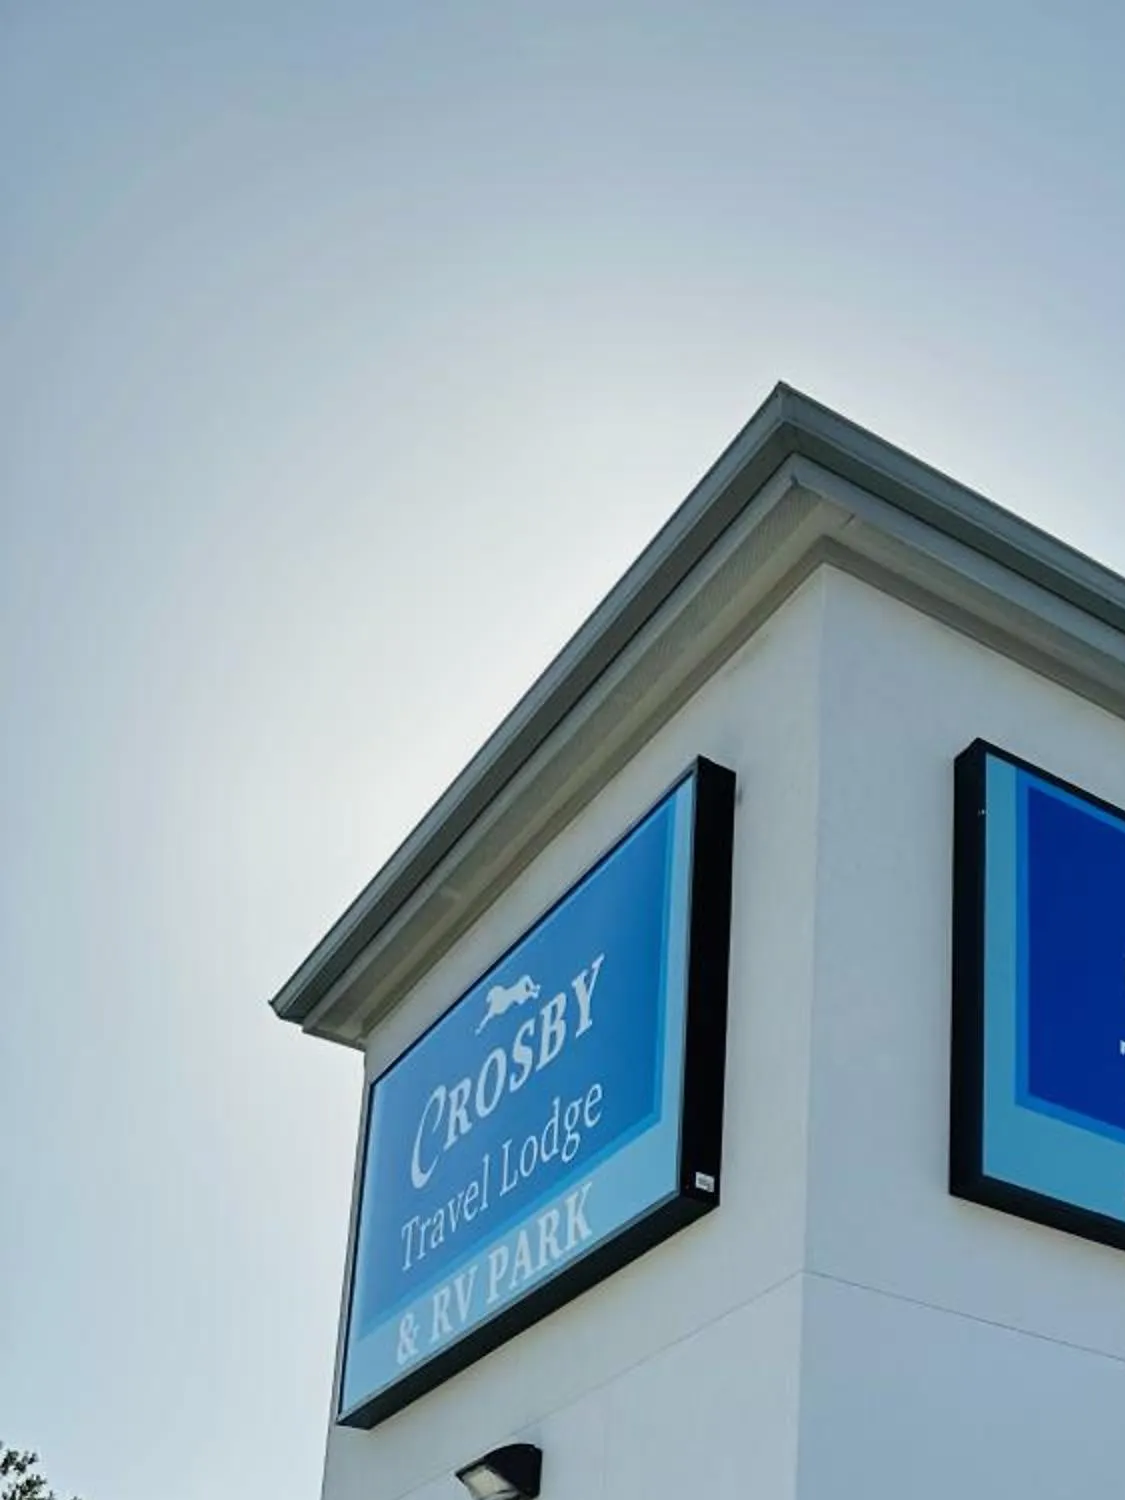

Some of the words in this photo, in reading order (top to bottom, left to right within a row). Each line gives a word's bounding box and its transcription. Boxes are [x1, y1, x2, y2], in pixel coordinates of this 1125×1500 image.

[410, 954, 604, 1188] CROSBY
[401, 1169, 489, 1272] Travel
[500, 1082, 603, 1197] Lodge
[395, 1311, 418, 1365] &
[430, 1267, 478, 1345] RV
[487, 1182, 593, 1304] PARK
